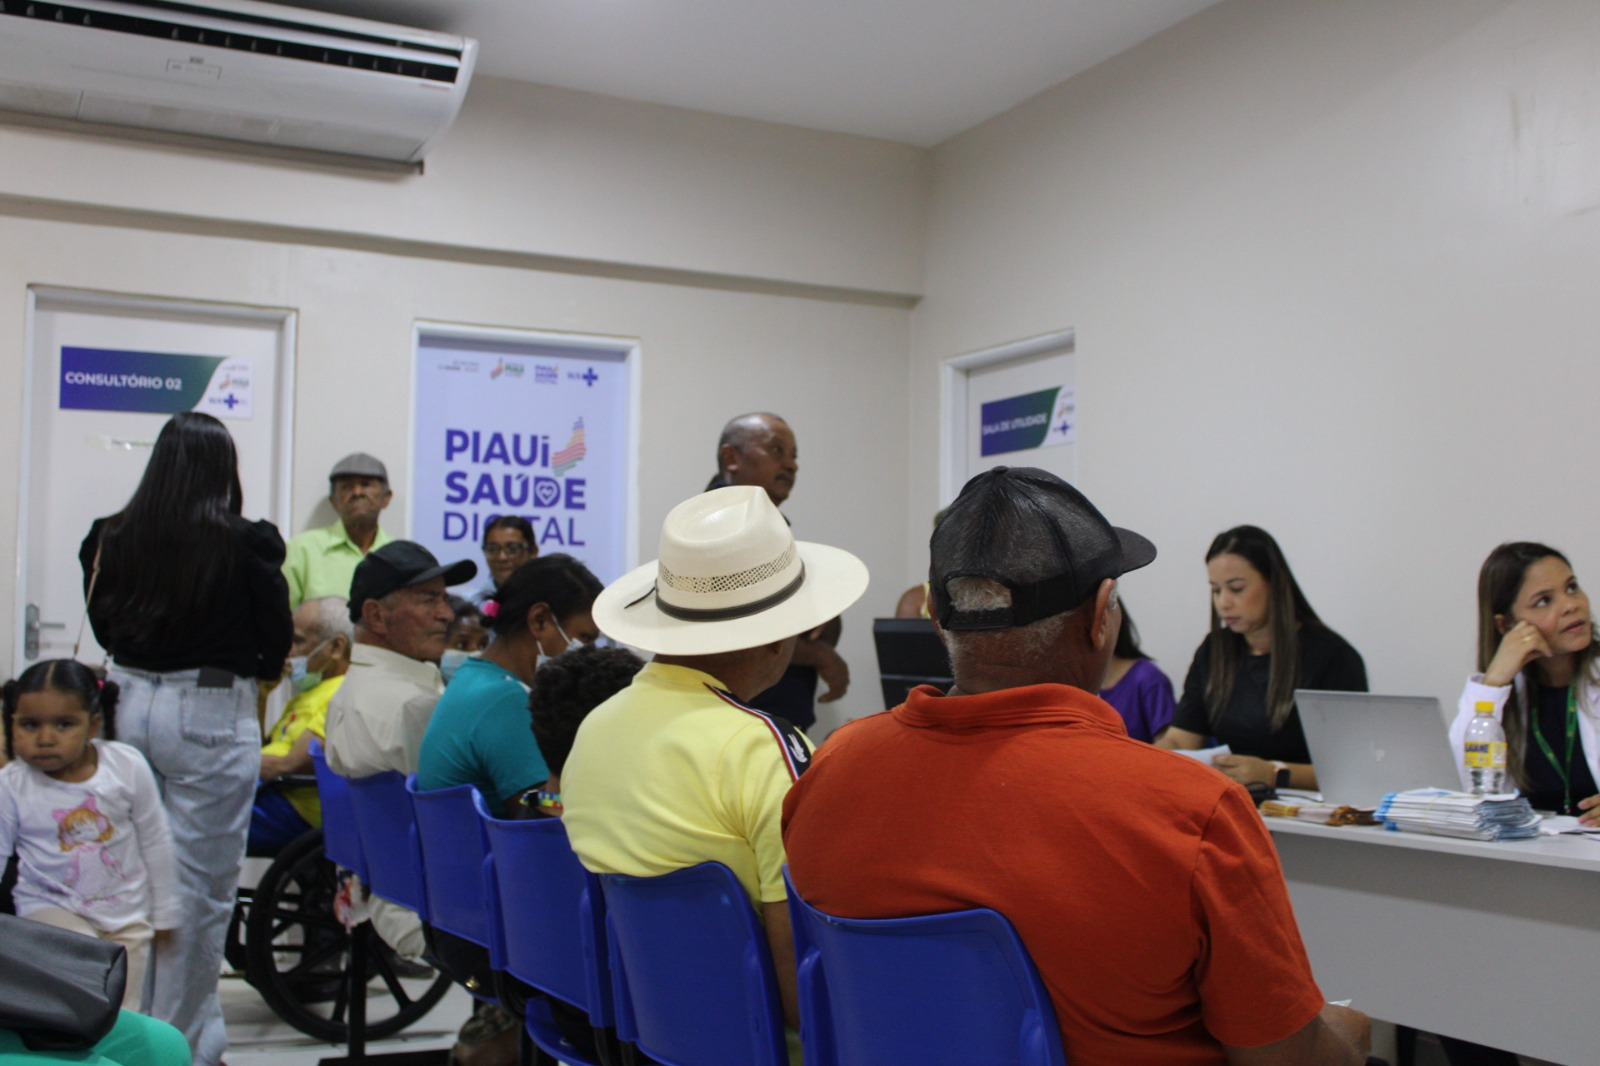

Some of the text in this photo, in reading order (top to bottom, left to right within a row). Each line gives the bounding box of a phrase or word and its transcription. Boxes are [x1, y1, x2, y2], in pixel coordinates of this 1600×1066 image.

[64, 371, 182, 390] CONSULTÓRIO 02
[445, 470, 586, 510] SAÚDE
